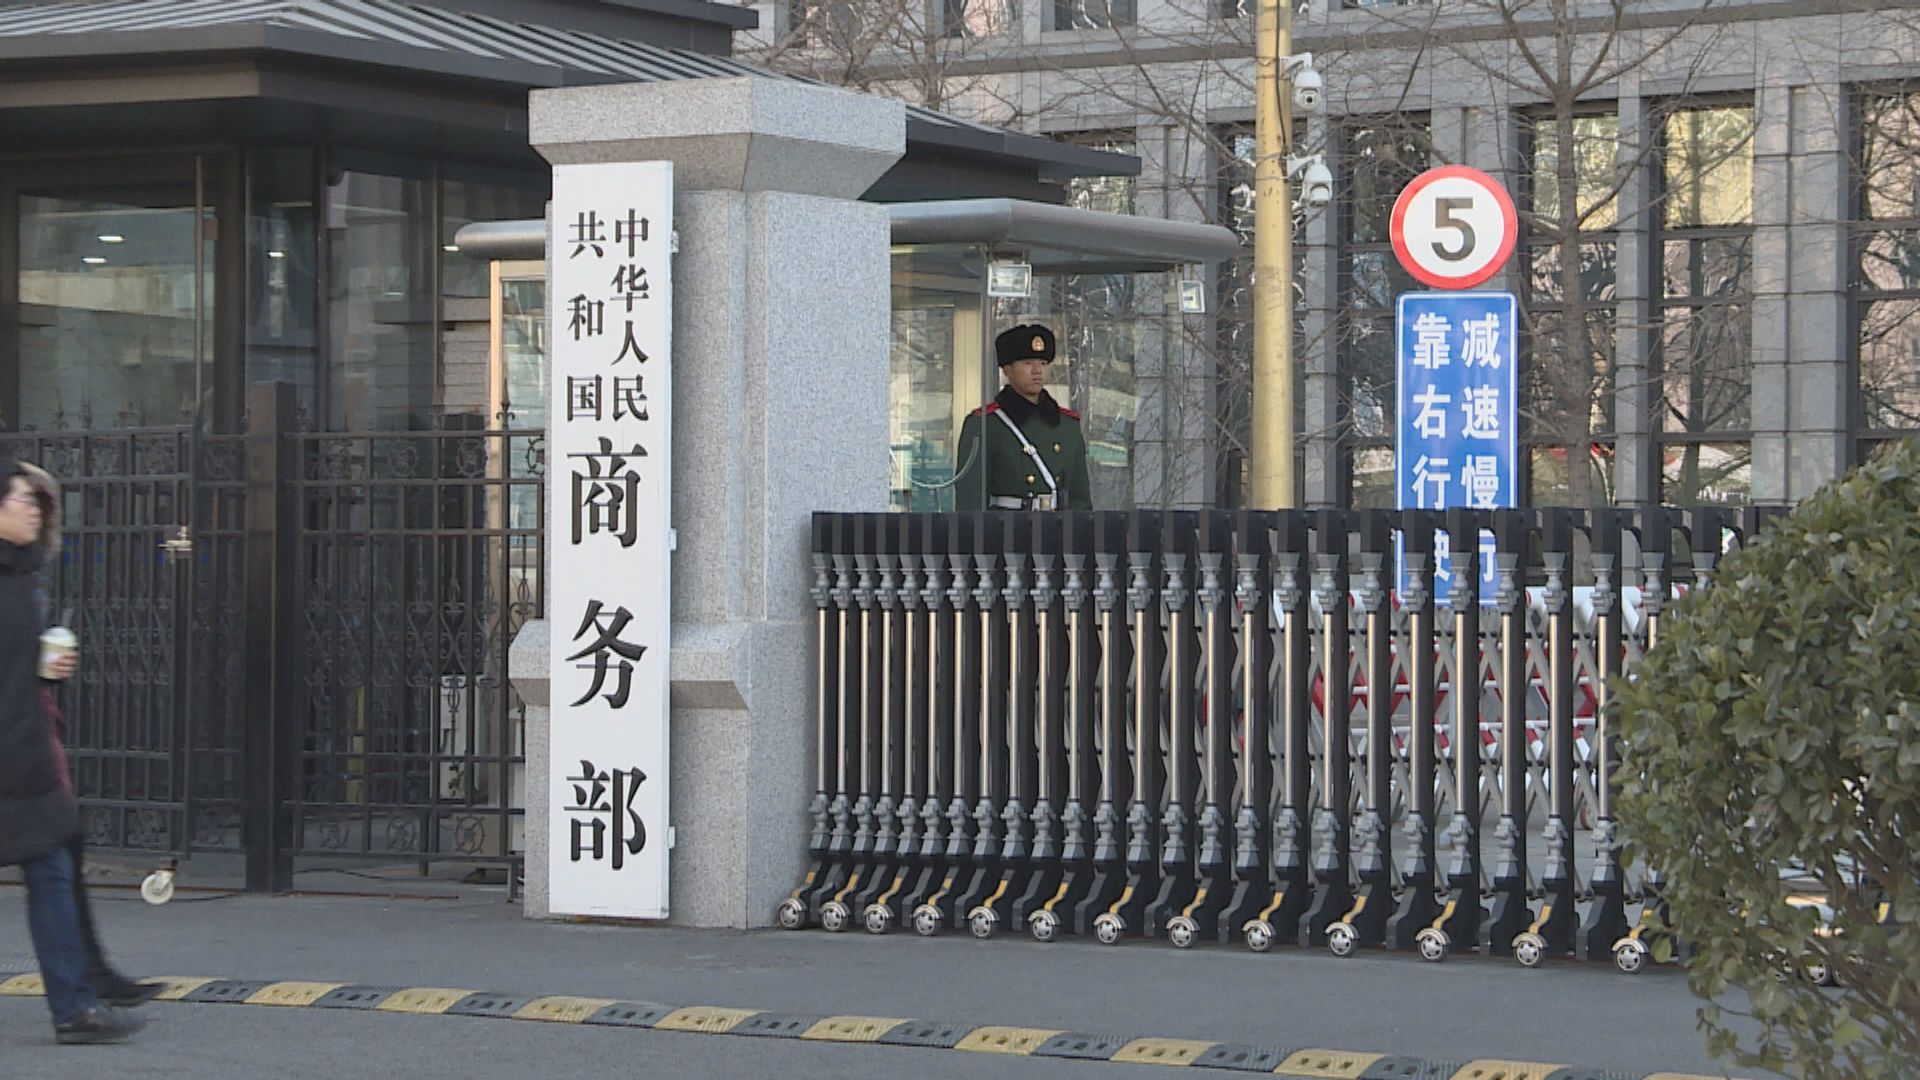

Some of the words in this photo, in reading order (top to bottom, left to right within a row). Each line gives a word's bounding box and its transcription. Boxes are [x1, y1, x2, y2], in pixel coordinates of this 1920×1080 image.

[567, 210, 607, 422] 共和国
[609, 207, 649, 422] 中华人民
[1430, 196, 1477, 262] 5
[563, 436, 649, 871] 商务部
